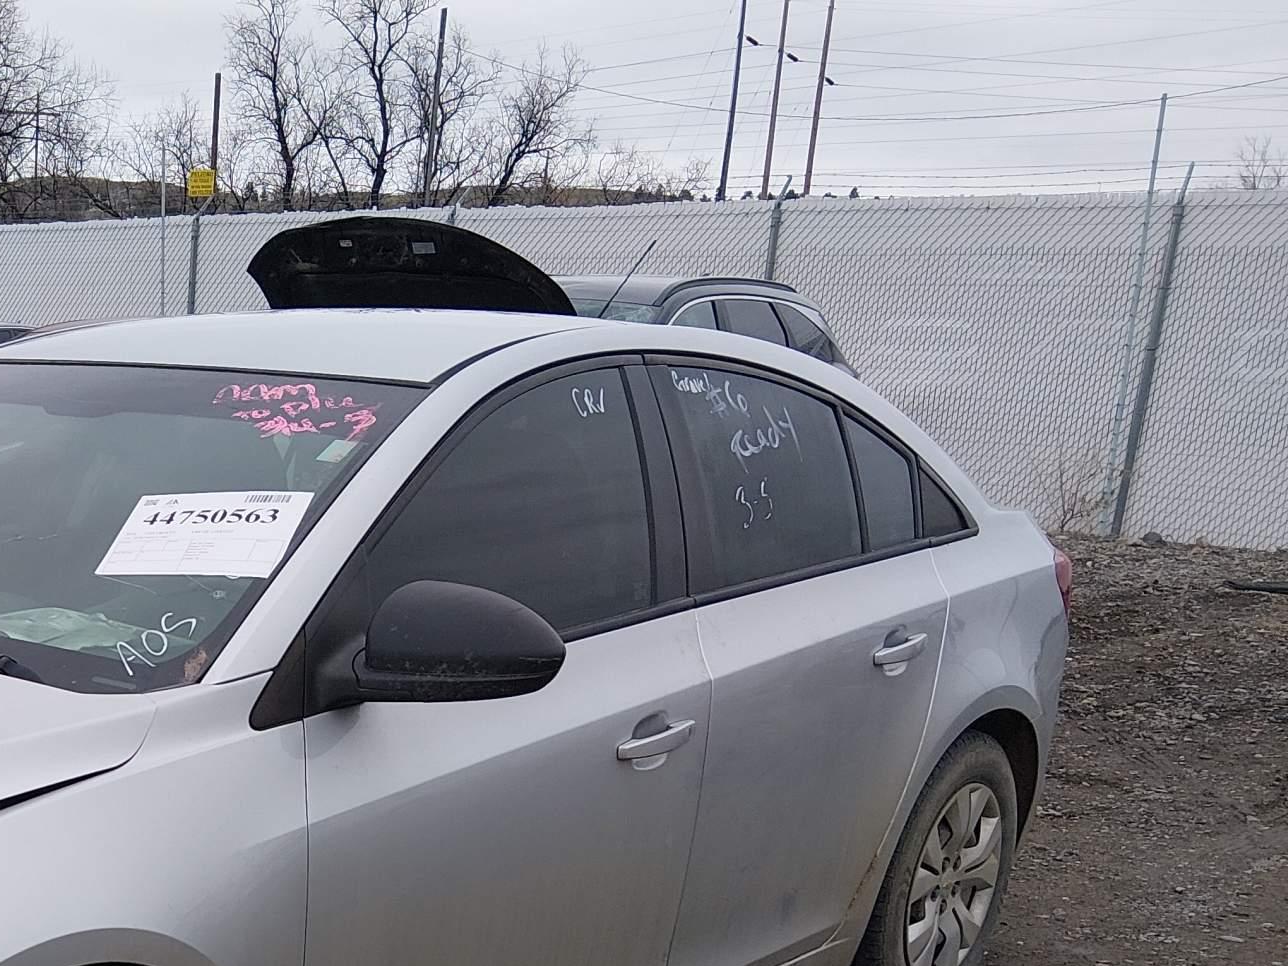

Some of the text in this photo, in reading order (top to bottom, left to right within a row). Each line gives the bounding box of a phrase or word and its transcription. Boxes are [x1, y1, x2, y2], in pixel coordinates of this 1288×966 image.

[571, 386, 606, 418] CRV
[730, 405, 803, 474] Ready
[143, 507, 280, 526] 44750563
